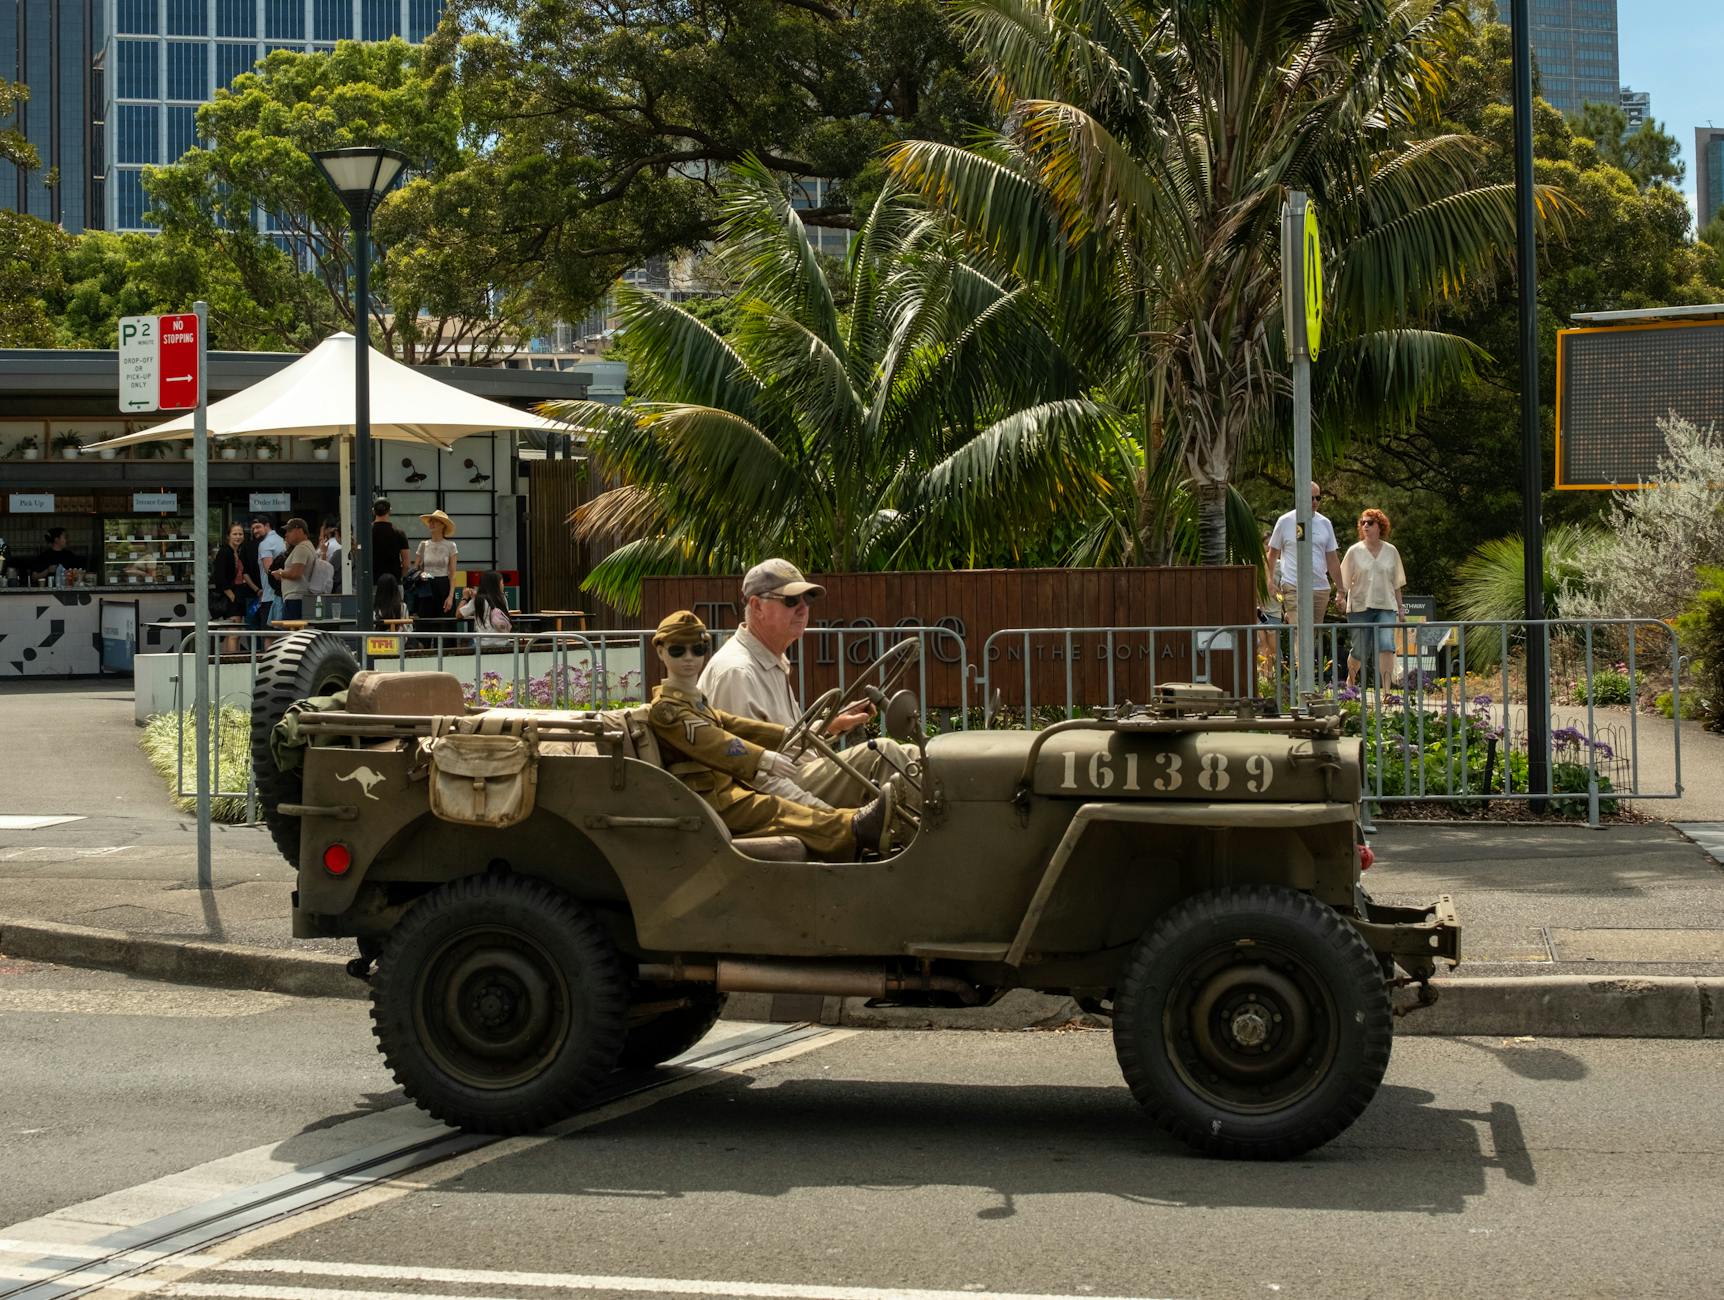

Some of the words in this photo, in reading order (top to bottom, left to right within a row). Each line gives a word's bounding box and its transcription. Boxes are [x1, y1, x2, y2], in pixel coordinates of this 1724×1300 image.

[123, 324, 137, 346] P
[142, 324, 151, 337] 2
[172, 320, 184, 331] NO
[163, 333, 194, 344] STOPPING
[1576, 349, 1669, 385] THIS
[692, 601, 966, 664] Trace
[370, 639, 395, 649] TFH
[986, 644, 1021, 661] ON
[1036, 643, 1082, 660] THE
[1060, 751, 1274, 793] 161389
